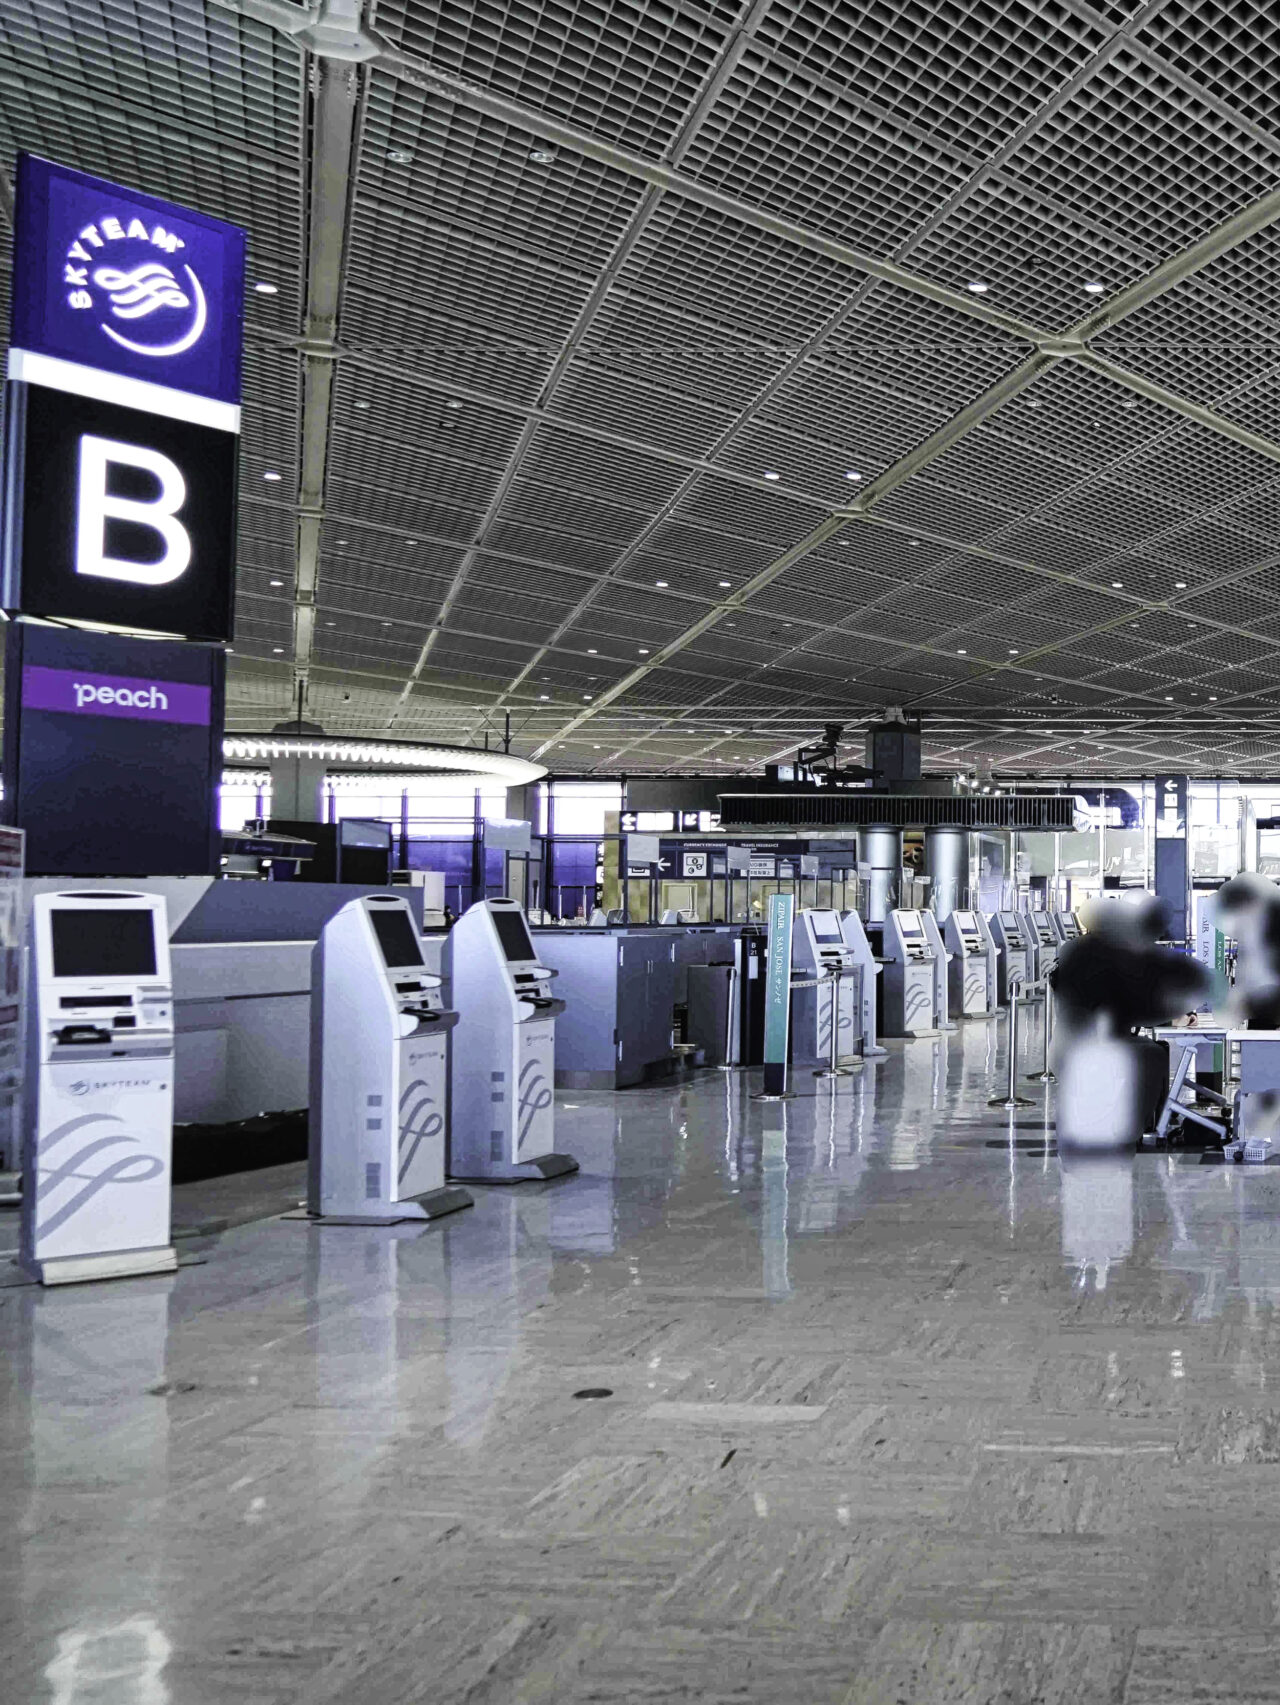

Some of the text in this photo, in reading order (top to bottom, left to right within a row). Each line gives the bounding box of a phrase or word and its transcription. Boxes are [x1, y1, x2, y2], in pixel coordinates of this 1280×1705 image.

[64, 215, 182, 310] SKYTEAM
[75, 432, 192, 586] B
[73, 682, 168, 710] peach
[777, 901, 786, 930] ZIPAIR
[774, 936, 784, 975] SAN JOSE
